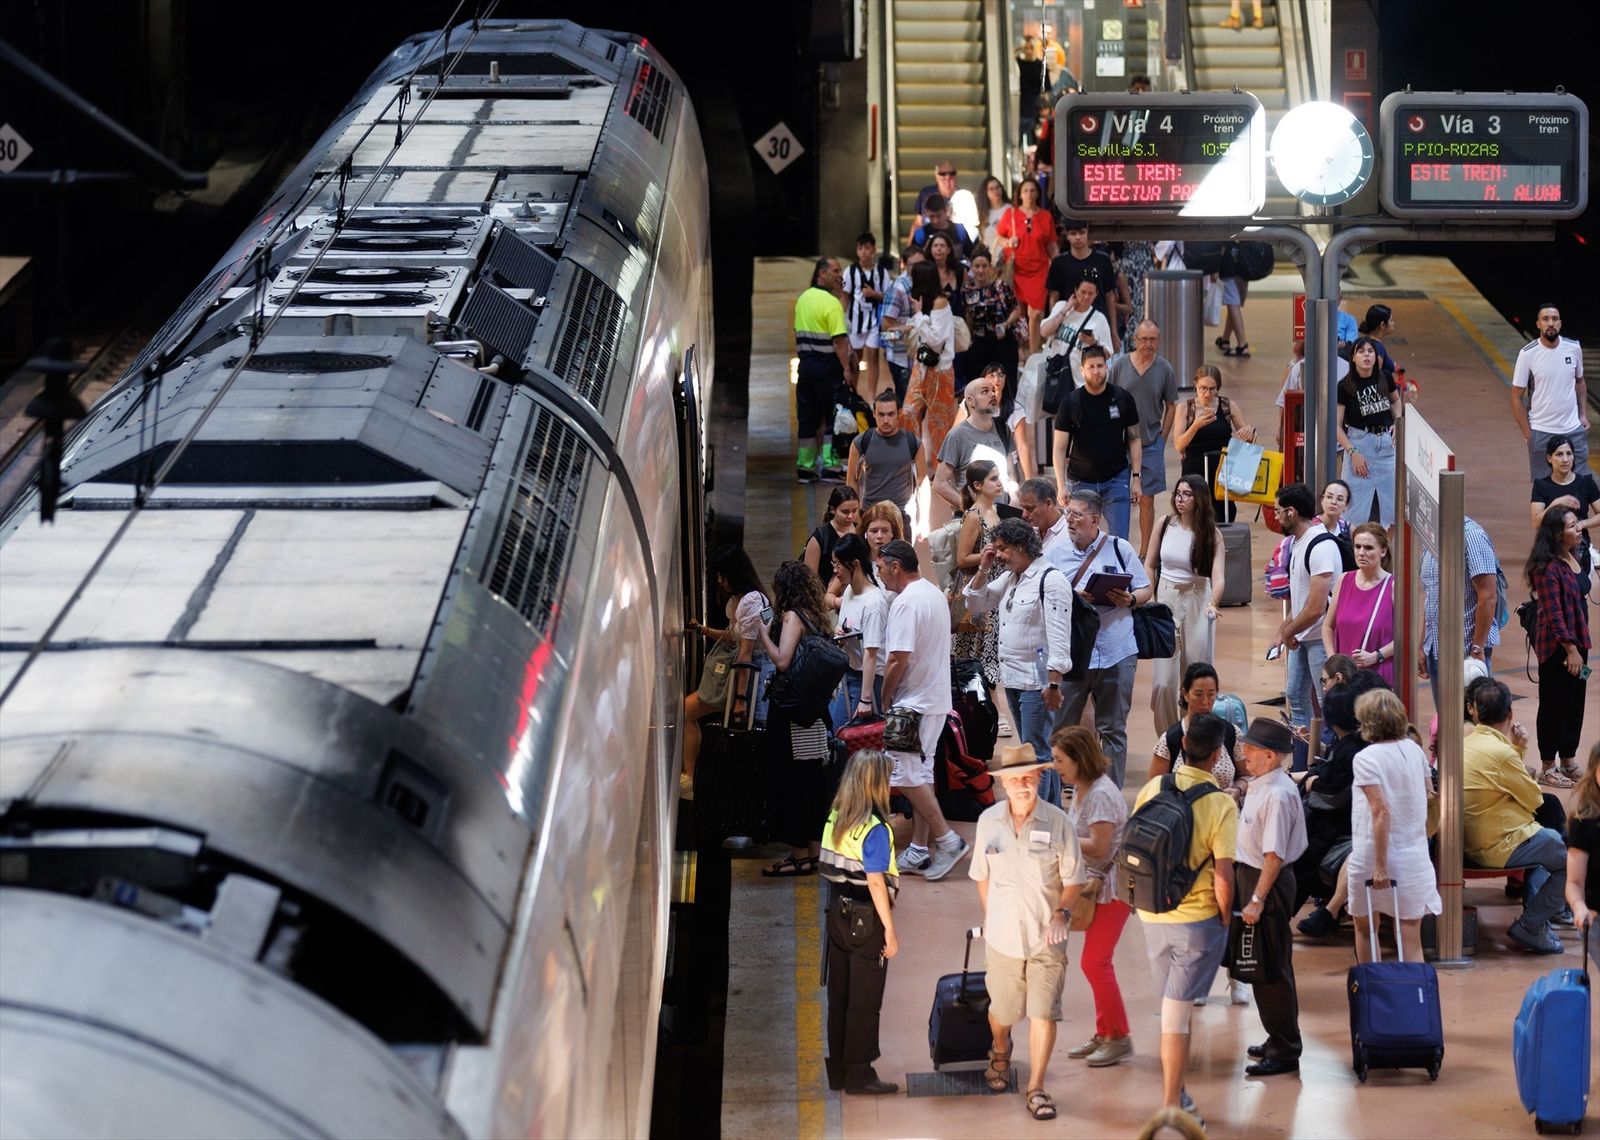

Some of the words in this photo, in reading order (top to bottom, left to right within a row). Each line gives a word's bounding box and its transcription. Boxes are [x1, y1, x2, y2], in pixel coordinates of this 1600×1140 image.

[1112, 114, 1147, 134] Vía
[1159, 115, 1173, 134] 4
[1203, 114, 1244, 124] Próximo
[1440, 114, 1474, 134] Vía
[1488, 115, 1501, 134] 3
[1529, 115, 1569, 125] Próximo
[1213, 124, 1234, 133] tren
[1539, 125, 1559, 134] tren
[769, 136, 790, 159] 30
[1077, 143, 1130, 156] Sevilla
[1134, 144, 1159, 156] S.J.
[1201, 142, 1232, 156] 10:5
[1404, 143, 1499, 156] P.PIO-ROZAS
[1084, 164, 1125, 181] ESTE
[1136, 164, 1182, 181] TREN:
[1411, 164, 1450, 181] ESTE
[1462, 164, 1508, 181] TREN:
[1089, 185, 1160, 201] EFECTUA
